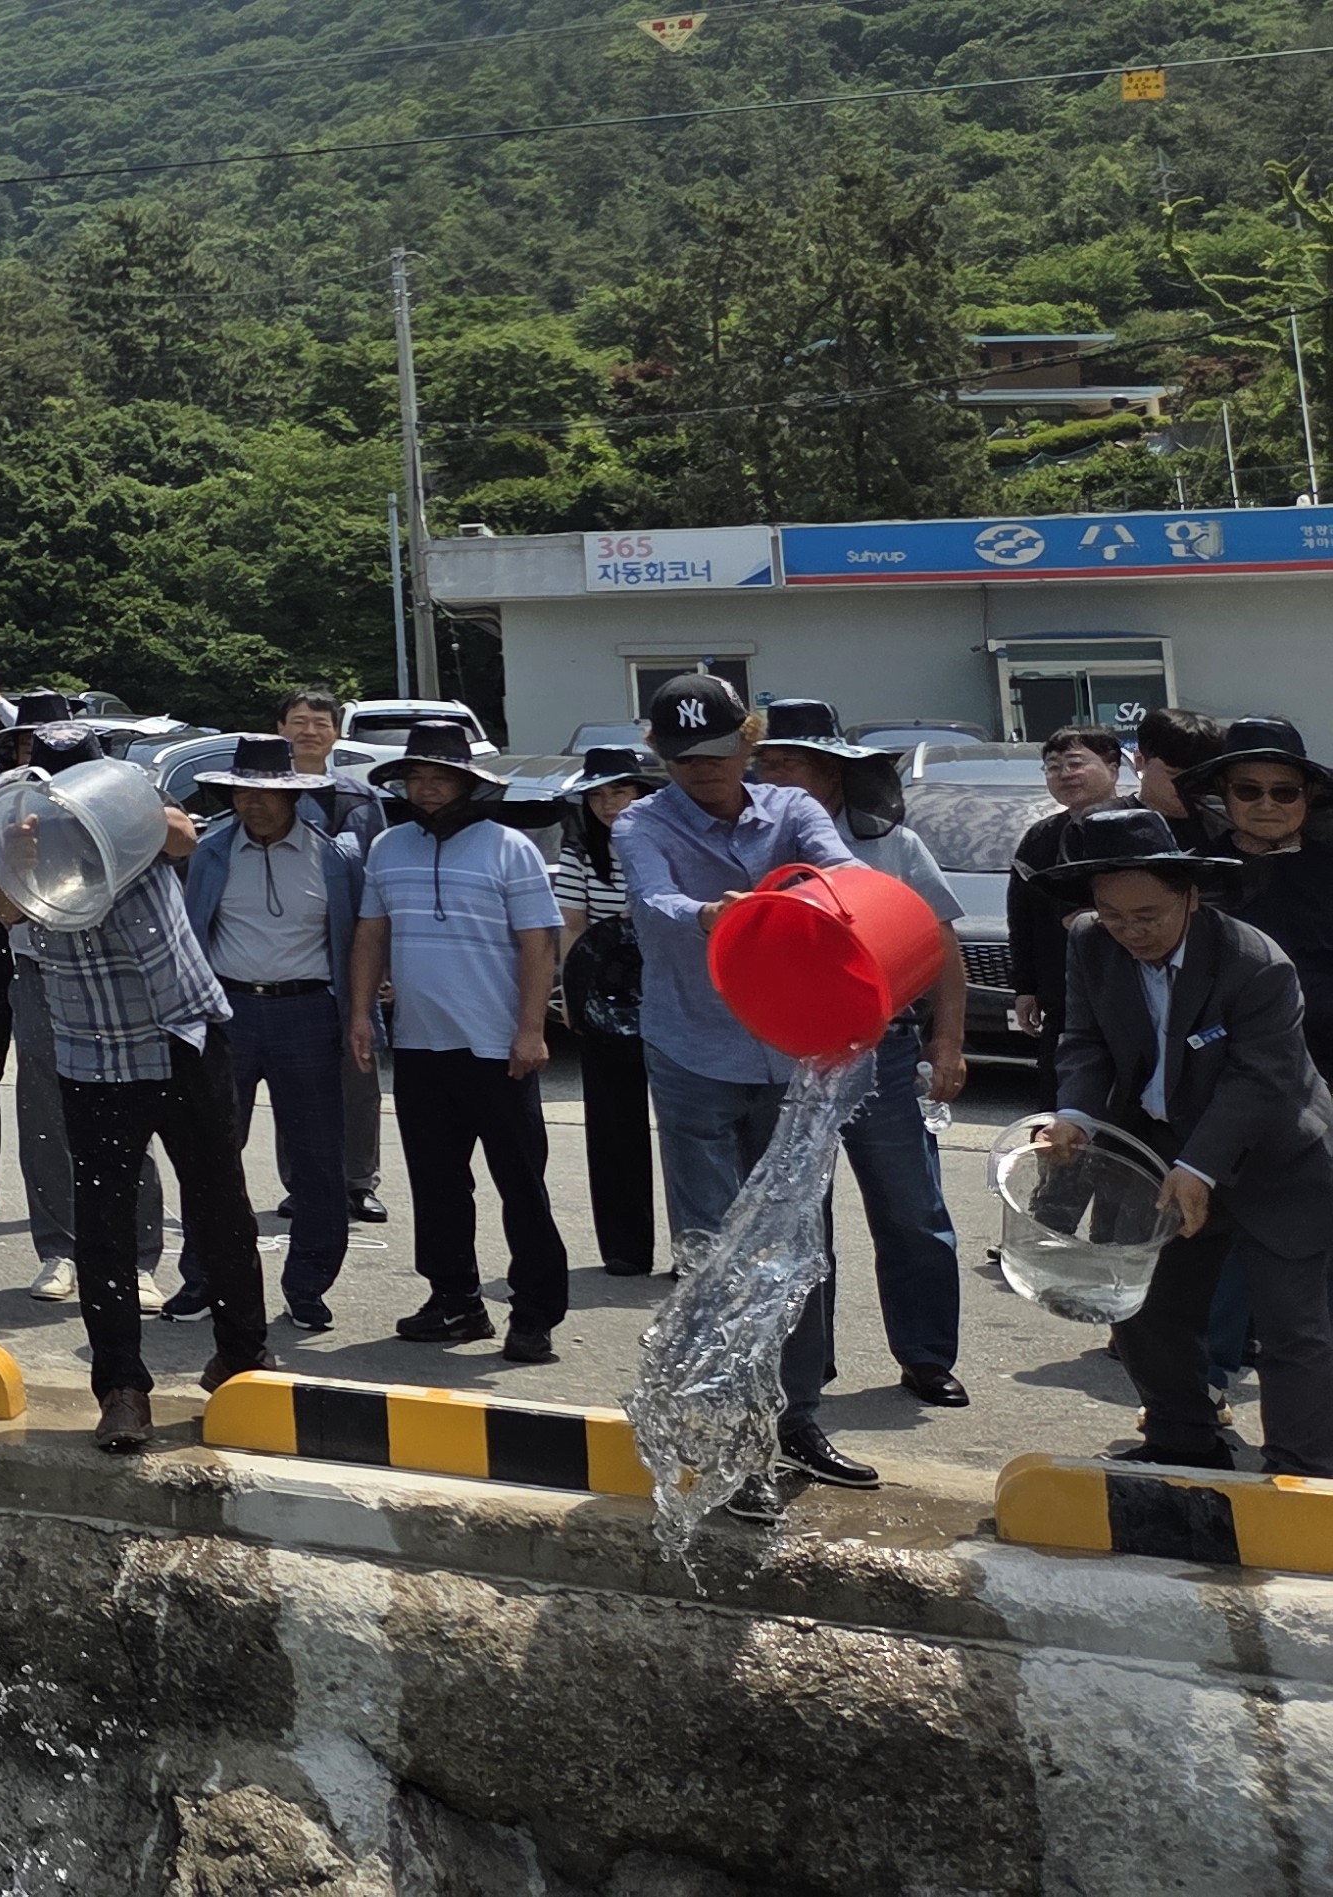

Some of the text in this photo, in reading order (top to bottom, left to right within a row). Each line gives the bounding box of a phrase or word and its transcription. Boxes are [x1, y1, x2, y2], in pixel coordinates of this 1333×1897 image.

[597, 536, 654, 559] 365
[597, 559, 713, 585] 자동화코너
[676, 698, 708, 728] NY
[1114, 702, 1147, 722] Sh
